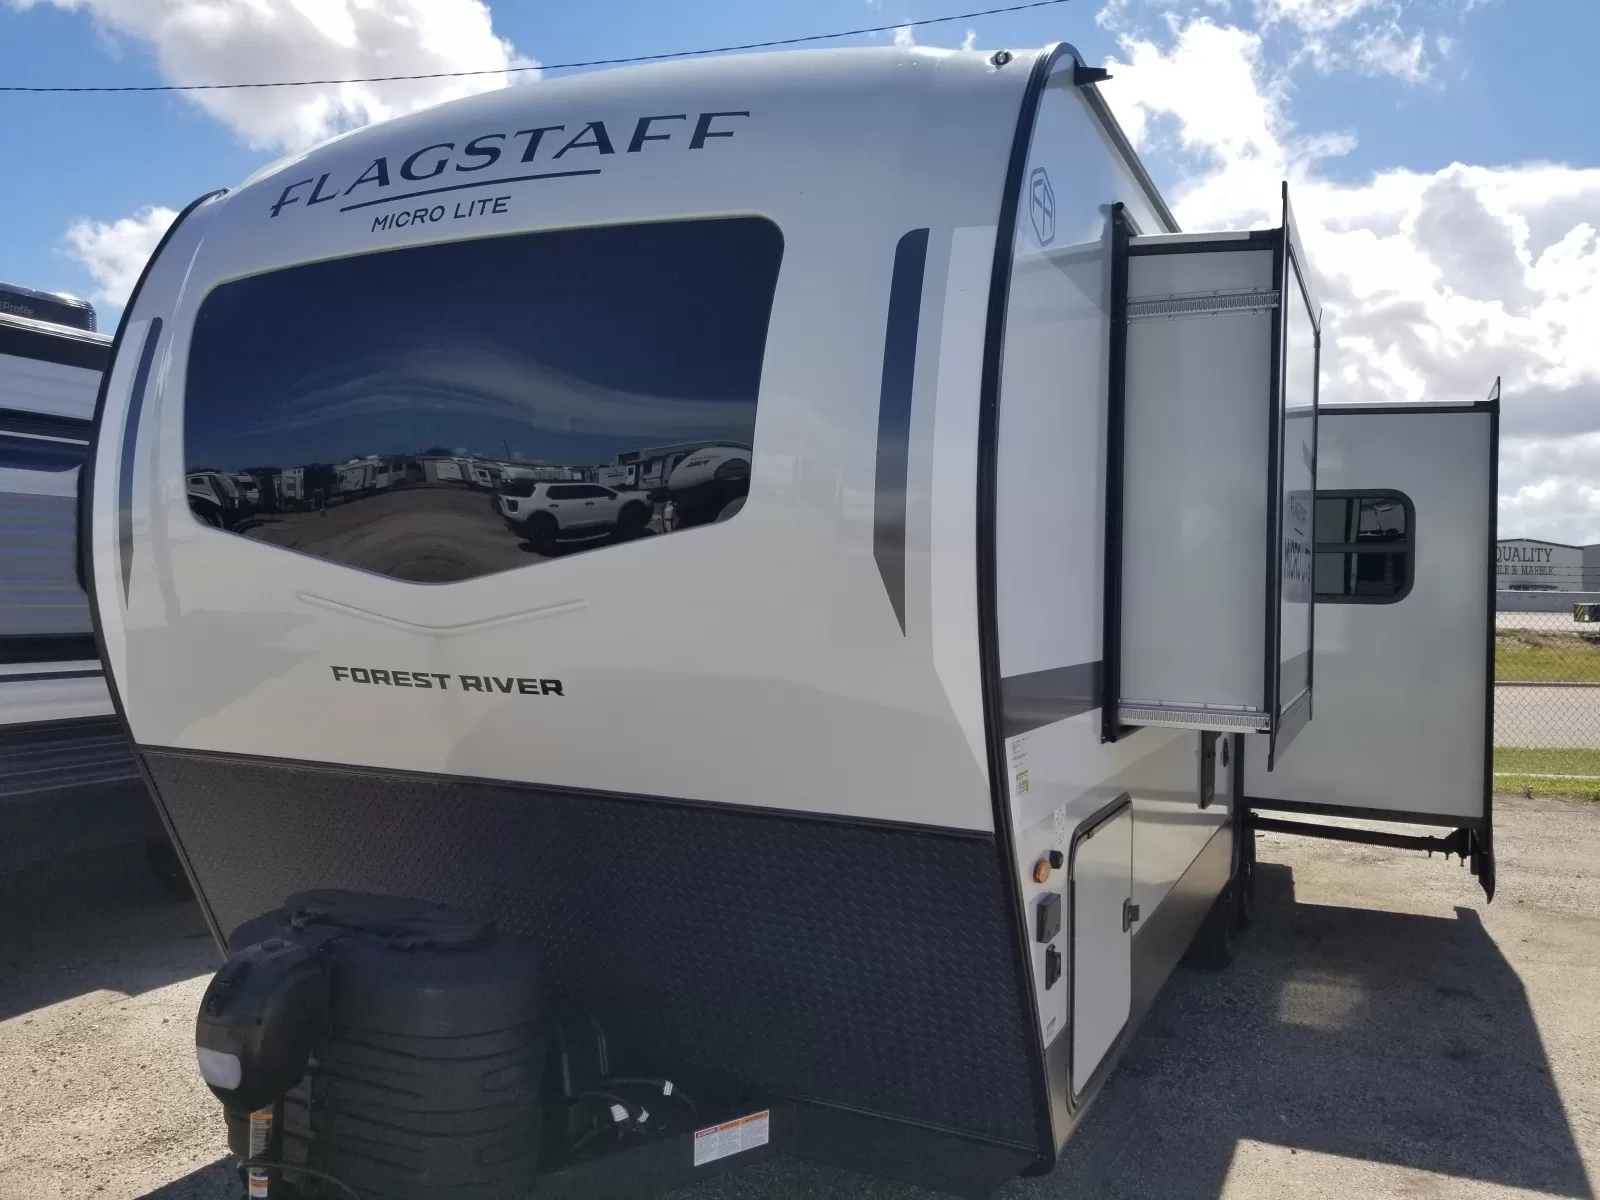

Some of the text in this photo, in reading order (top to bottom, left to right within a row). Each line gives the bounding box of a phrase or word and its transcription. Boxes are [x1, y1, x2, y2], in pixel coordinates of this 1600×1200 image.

[270, 111, 750, 218] FLAGSTAFF
[371, 196, 511, 232] MICRO LITE
[3, 302, 34, 316] Profile
[1497, 565, 1553, 576] ILE & MARBLE
[330, 665, 565, 696] FOREST RIVER
